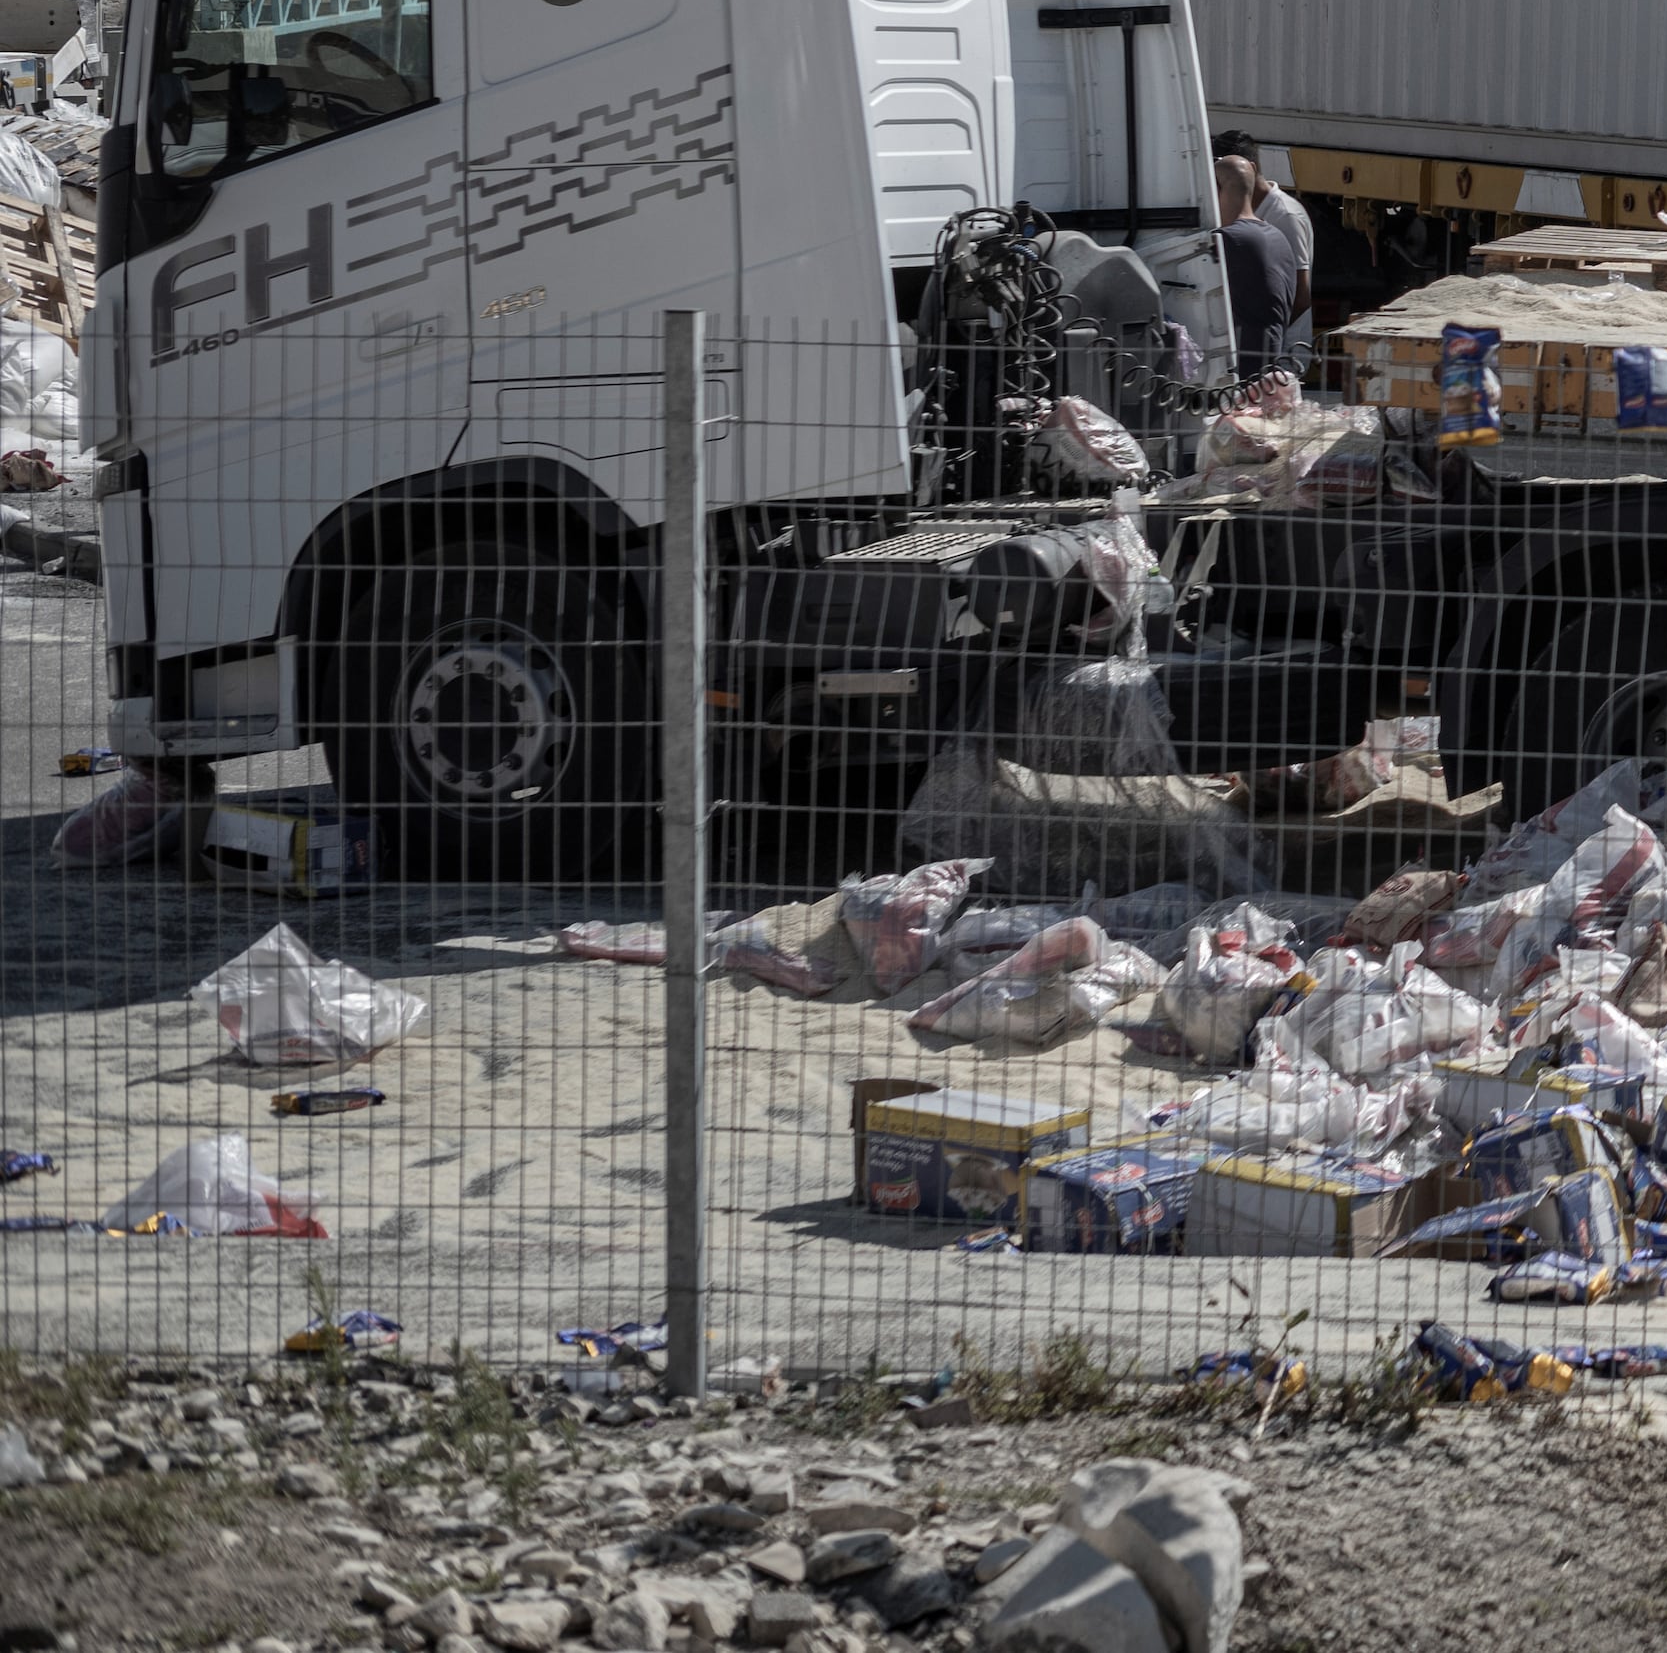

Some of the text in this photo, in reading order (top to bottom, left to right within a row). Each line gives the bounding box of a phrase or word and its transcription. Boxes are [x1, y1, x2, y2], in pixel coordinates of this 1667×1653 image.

[151, 202, 333, 356] FH
[479, 284, 547, 319] 460
[181, 328, 239, 357] 460
